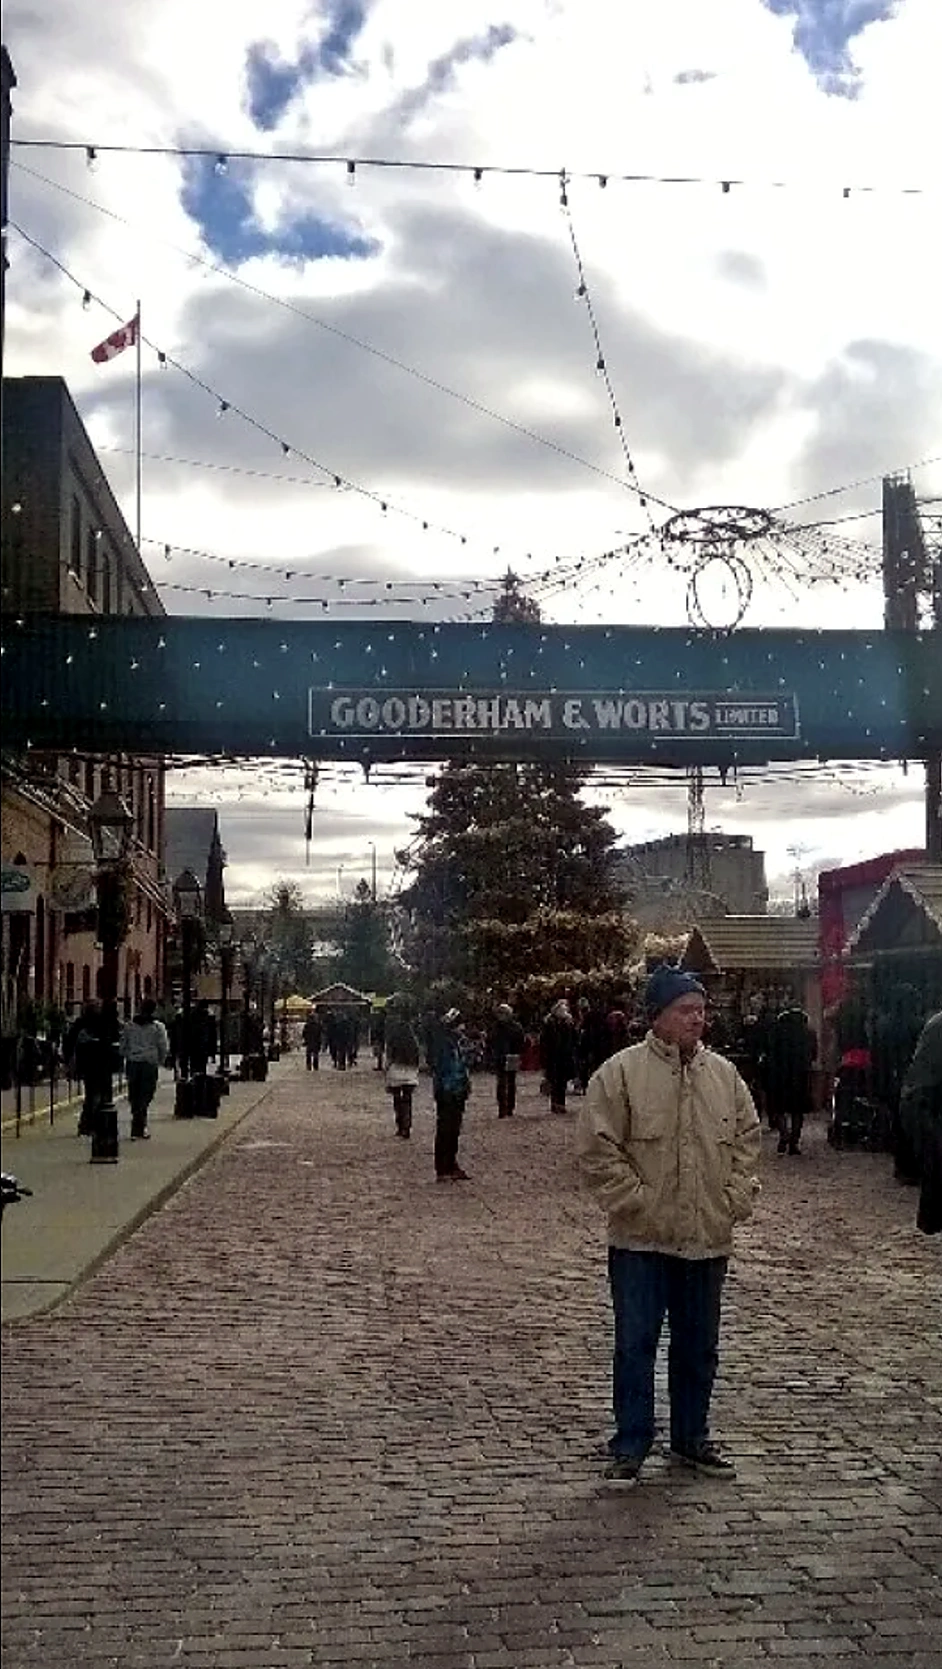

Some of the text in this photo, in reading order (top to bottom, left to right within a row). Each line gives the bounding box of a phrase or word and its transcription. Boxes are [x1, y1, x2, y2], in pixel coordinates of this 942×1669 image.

[330, 696, 779, 731] GOODERHAM & WORTS LIMITED
